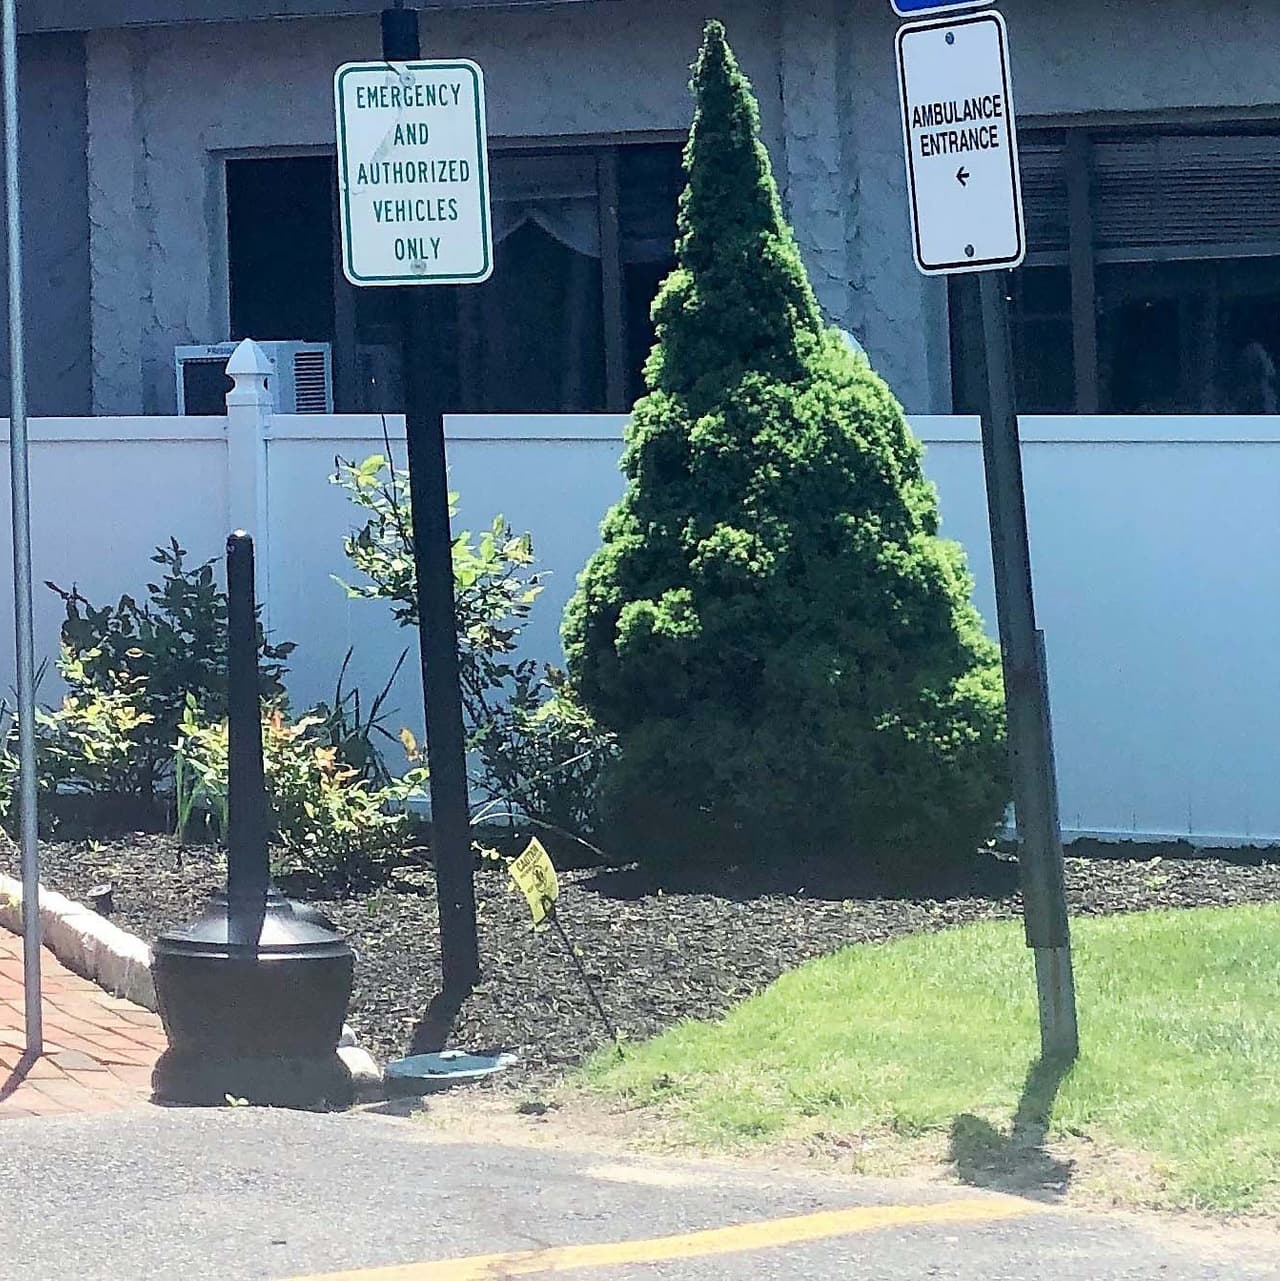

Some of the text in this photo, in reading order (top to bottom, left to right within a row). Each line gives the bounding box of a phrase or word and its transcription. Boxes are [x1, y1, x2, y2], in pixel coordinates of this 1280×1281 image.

[356, 83, 461, 110] EMERGENCY
[913, 94, 1002, 129] AMBULANCE
[393, 122, 429, 146] AND
[920, 125, 999, 157] ENTRANCE
[357, 159, 470, 185] AUTHORIZED
[372, 198, 458, 224] VEHICLES
[394, 237, 441, 261] ONLY
